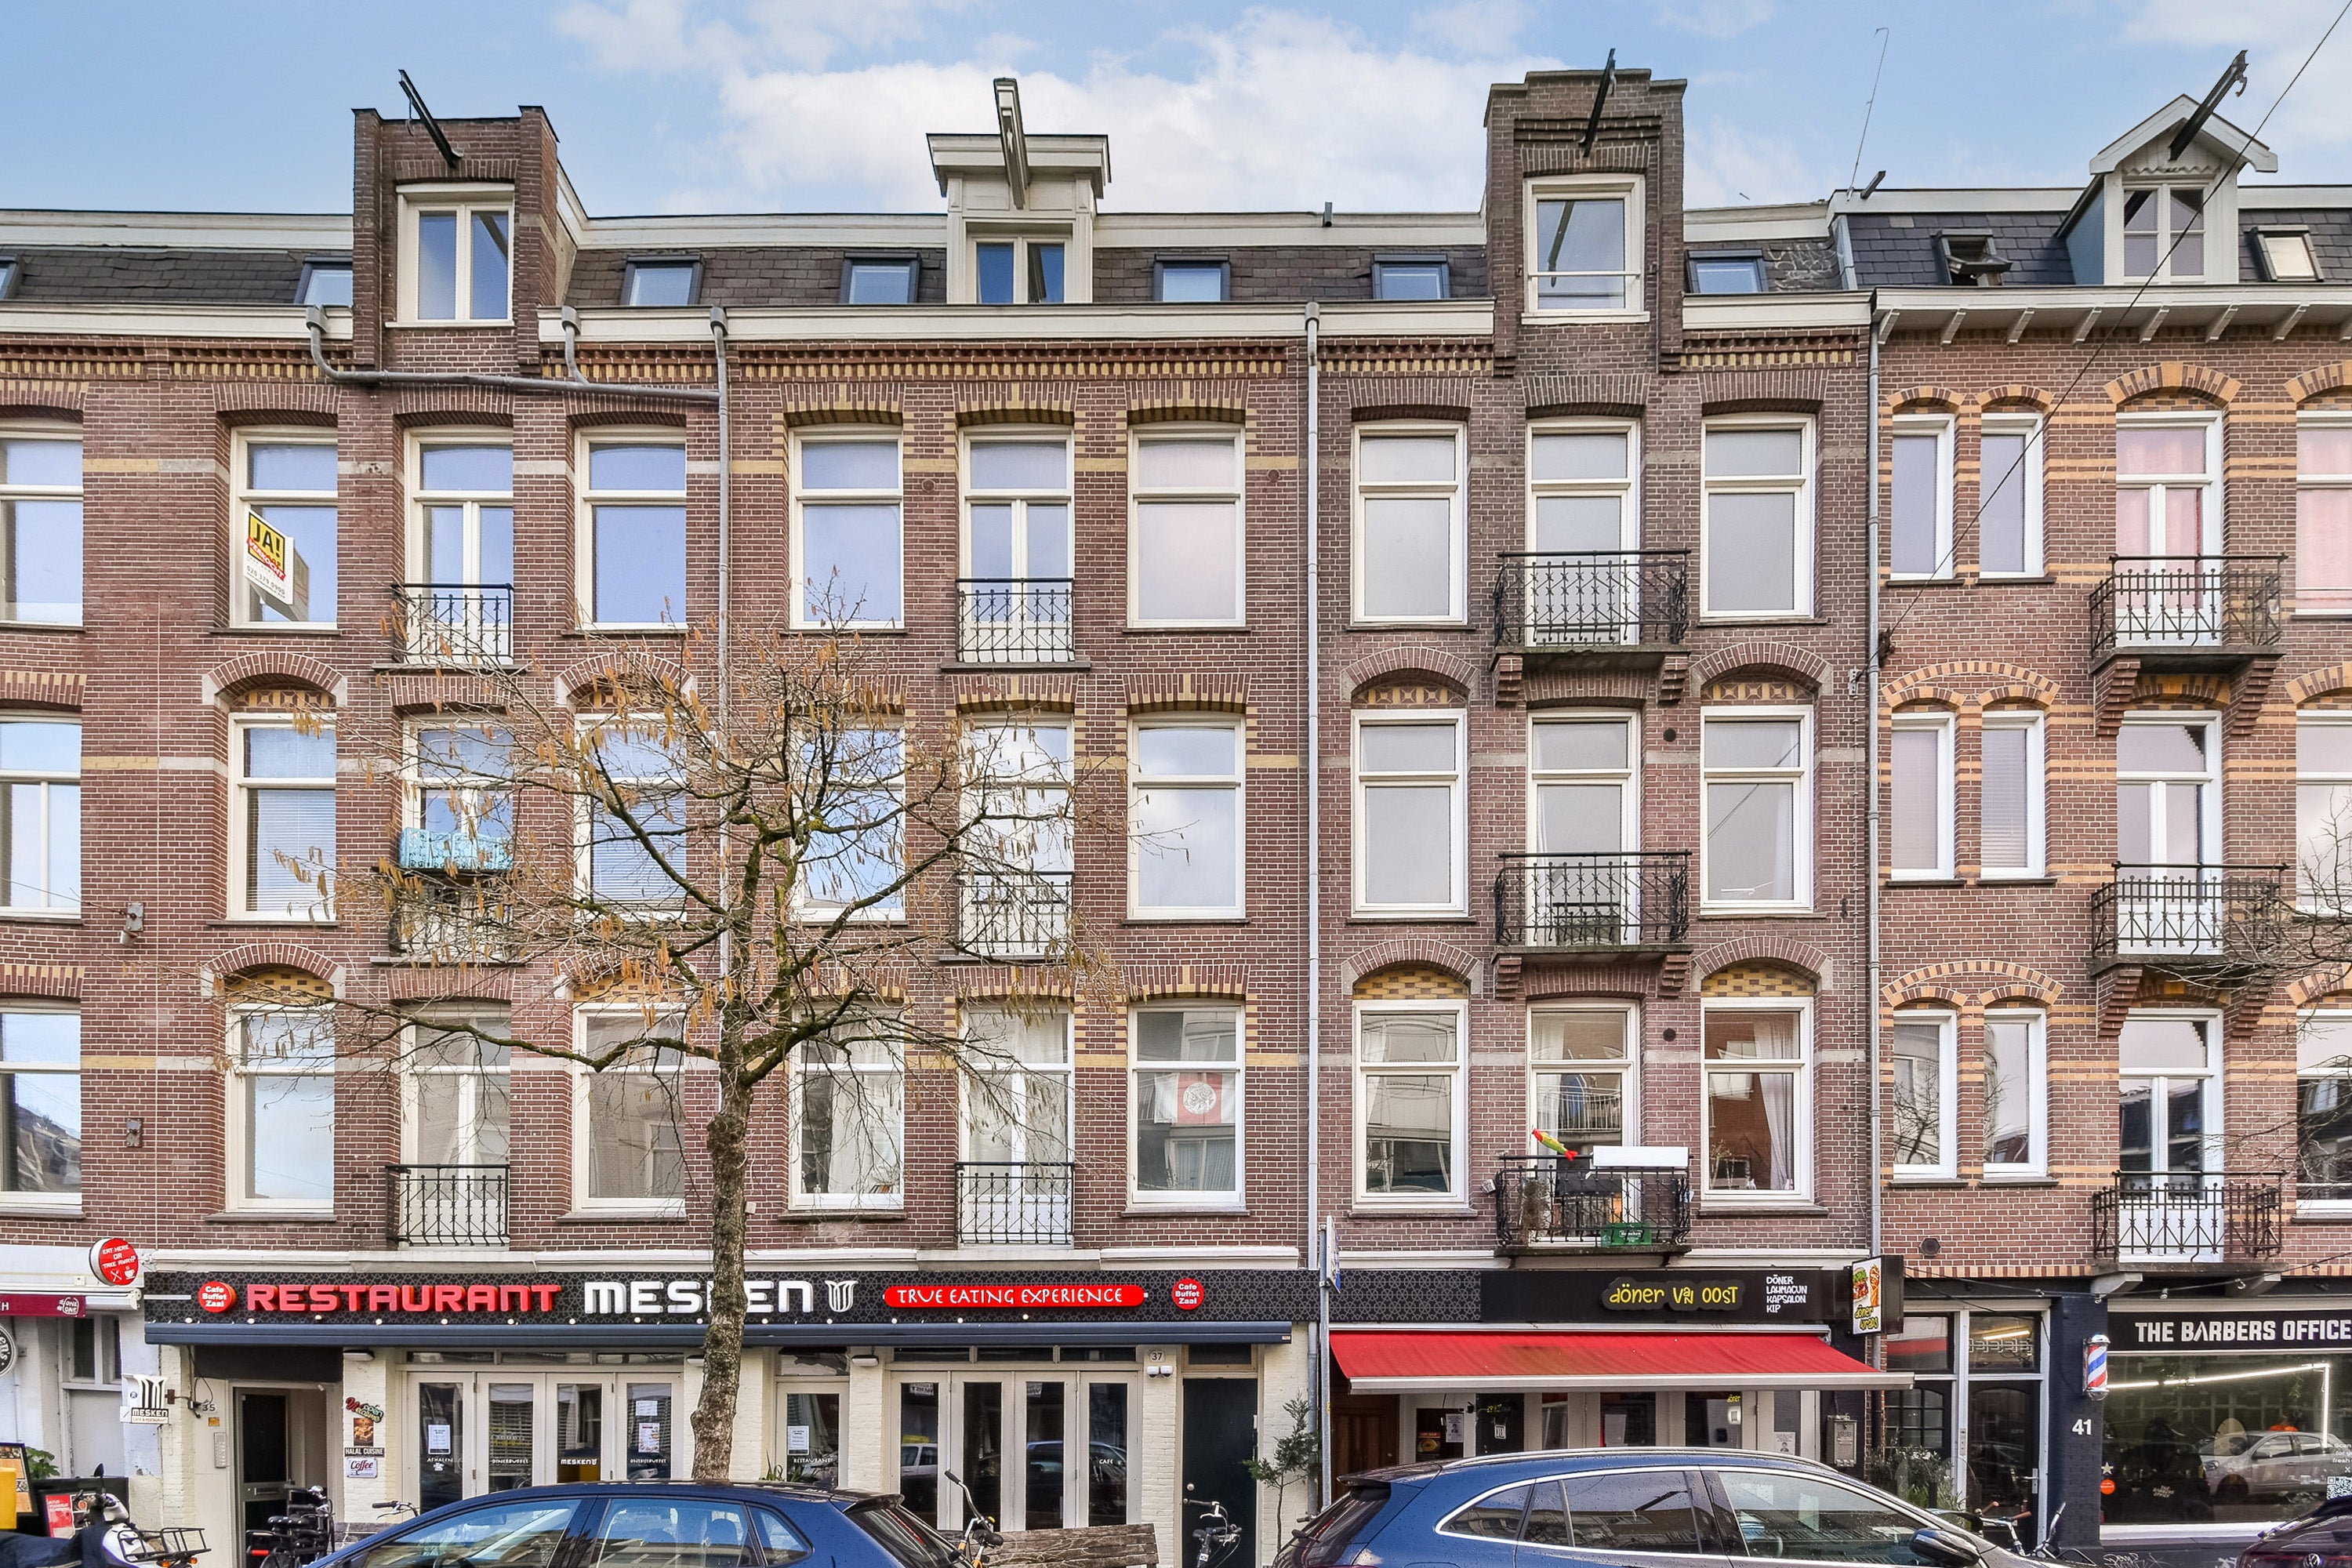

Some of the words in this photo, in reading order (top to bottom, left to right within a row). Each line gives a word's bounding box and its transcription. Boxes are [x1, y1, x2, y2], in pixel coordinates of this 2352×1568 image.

[253, 523, 281, 557] JA!
[248, 538, 284, 579] VERKOCHT
[247, 1283, 562, 1312] RESTAURANT
[584, 1280, 813, 1314] MESEN
[897, 1289, 943, 1304] TRUE
[949, 1288, 1014, 1305] EATING
[1021, 1288, 1123, 1304] EXPERIENCE
[1610, 1283, 1665, 1304] döner
[1766, 1285, 1808, 1294] LAHMACUN
[1766, 1295, 1807, 1304] KAPSALON
[1766, 1305, 1781, 1313] KIP
[2135, 1322, 2174, 1342] THE
[2181, 1320, 2276, 1342] BARBERS
[2282, 1319, 2352, 1341] OFFICE
[1151, 1352, 1163, 1361] 37
[132, 1408, 168, 1417] MESKEN
[202, 1403, 216, 1412] 35
[2071, 1418, 2092, 1436] 41
[350, 1459, 374, 1472] Coffee
